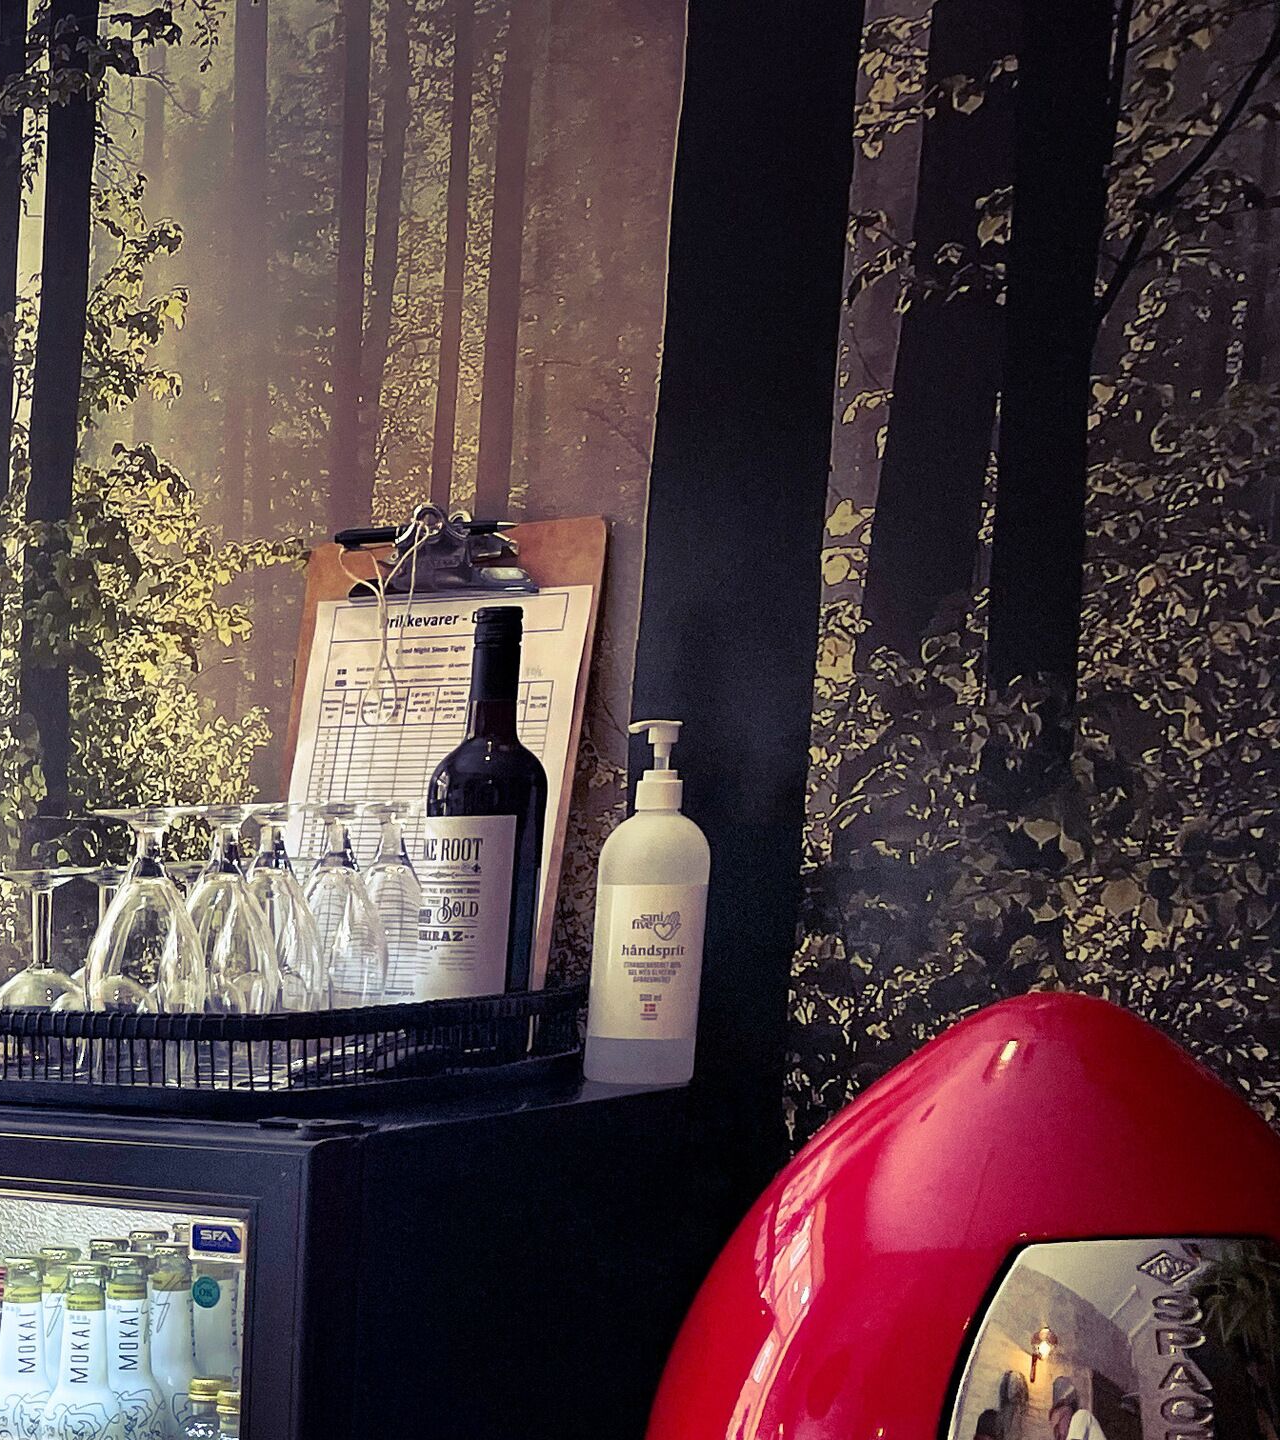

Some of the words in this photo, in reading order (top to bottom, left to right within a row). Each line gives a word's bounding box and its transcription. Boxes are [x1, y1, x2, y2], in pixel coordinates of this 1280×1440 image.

[384, 613, 459, 629] rikkevarer
[441, 838, 483, 861] ROOT
[640, 911, 664, 922] sani
[632, 919, 653, 930] five
[621, 944, 685, 958] håndsprit
[199, 1229, 232, 1242] SFA
